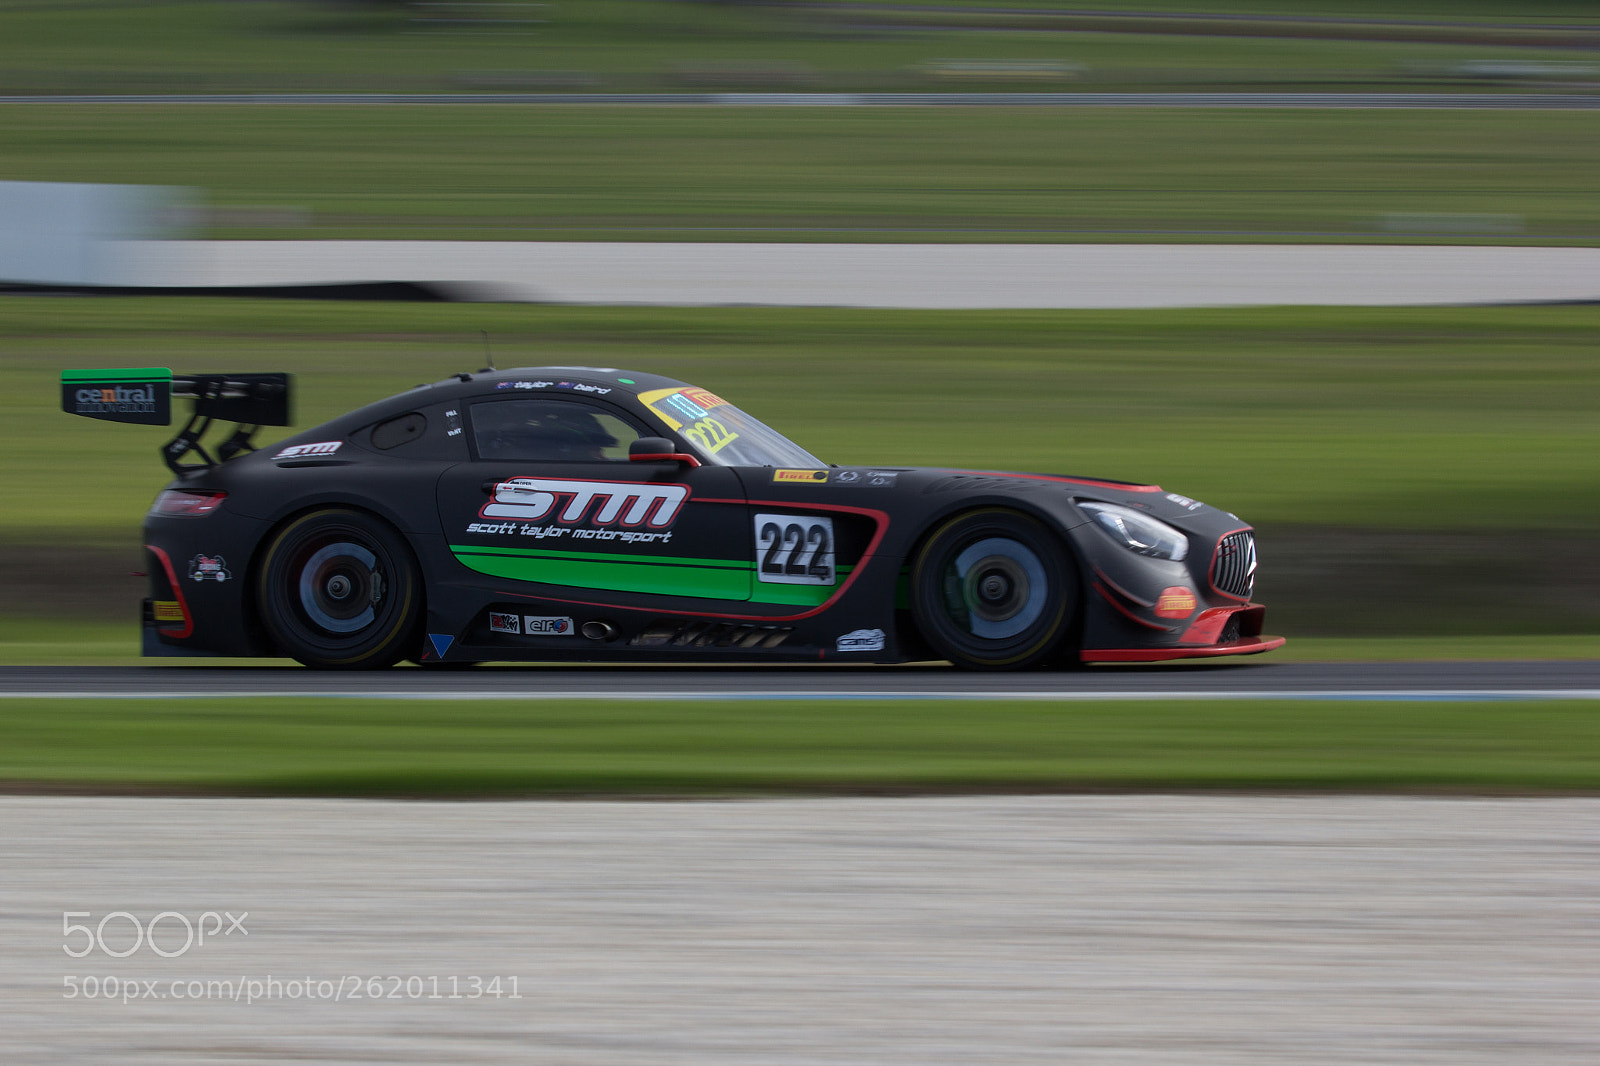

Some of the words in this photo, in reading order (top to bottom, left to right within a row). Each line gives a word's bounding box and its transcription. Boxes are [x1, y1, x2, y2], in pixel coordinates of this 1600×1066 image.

[75, 383, 156, 402] central
[513, 380, 554, 390] taylor
[573, 383, 612, 395] baird
[685, 417, 740, 455] 222
[466, 522, 517, 535] scott
[520, 525, 571, 539] taylor
[571, 528, 673, 544] motorsport
[760, 521, 831, 577] 222
[530, 620, 554, 632] elf
